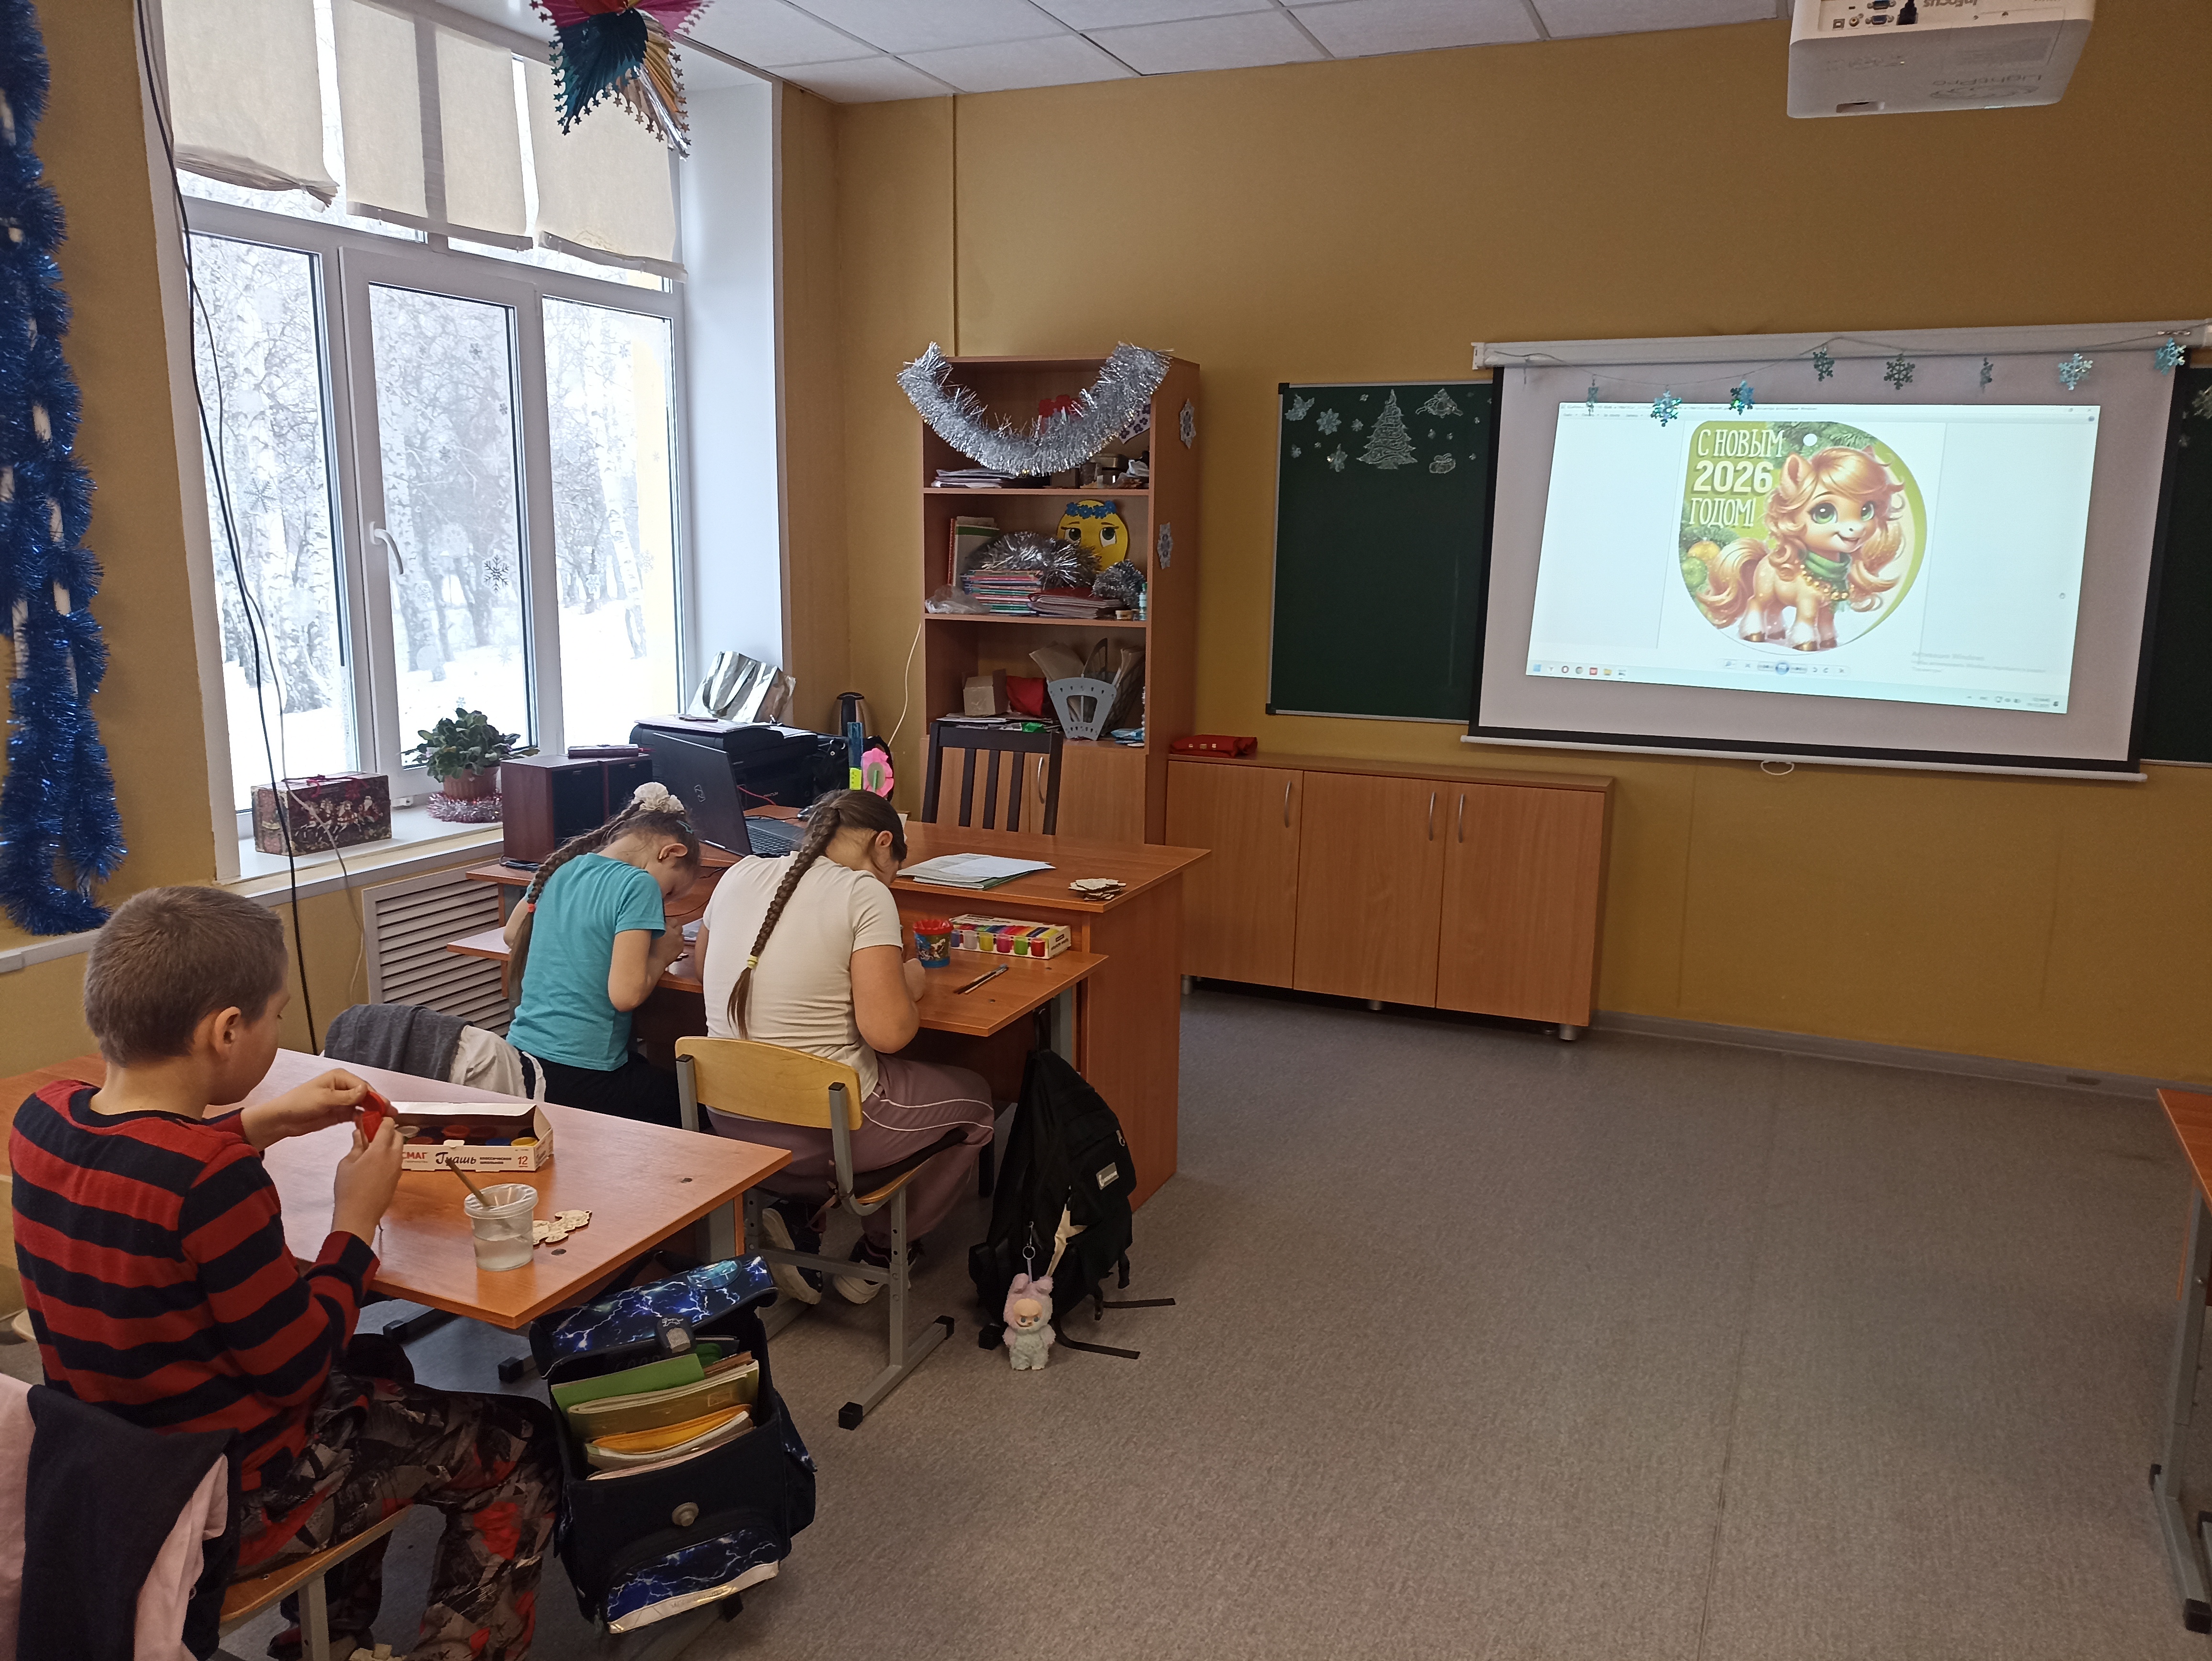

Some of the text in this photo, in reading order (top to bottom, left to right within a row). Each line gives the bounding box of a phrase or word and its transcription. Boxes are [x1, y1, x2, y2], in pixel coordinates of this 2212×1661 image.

[1698, 429, 1785, 457] С НОВЫМ
[1693, 460, 1773, 493] 2026
[1689, 498, 1756, 528] ГОДОМ!
[518, 1156, 528, 1165] 12
